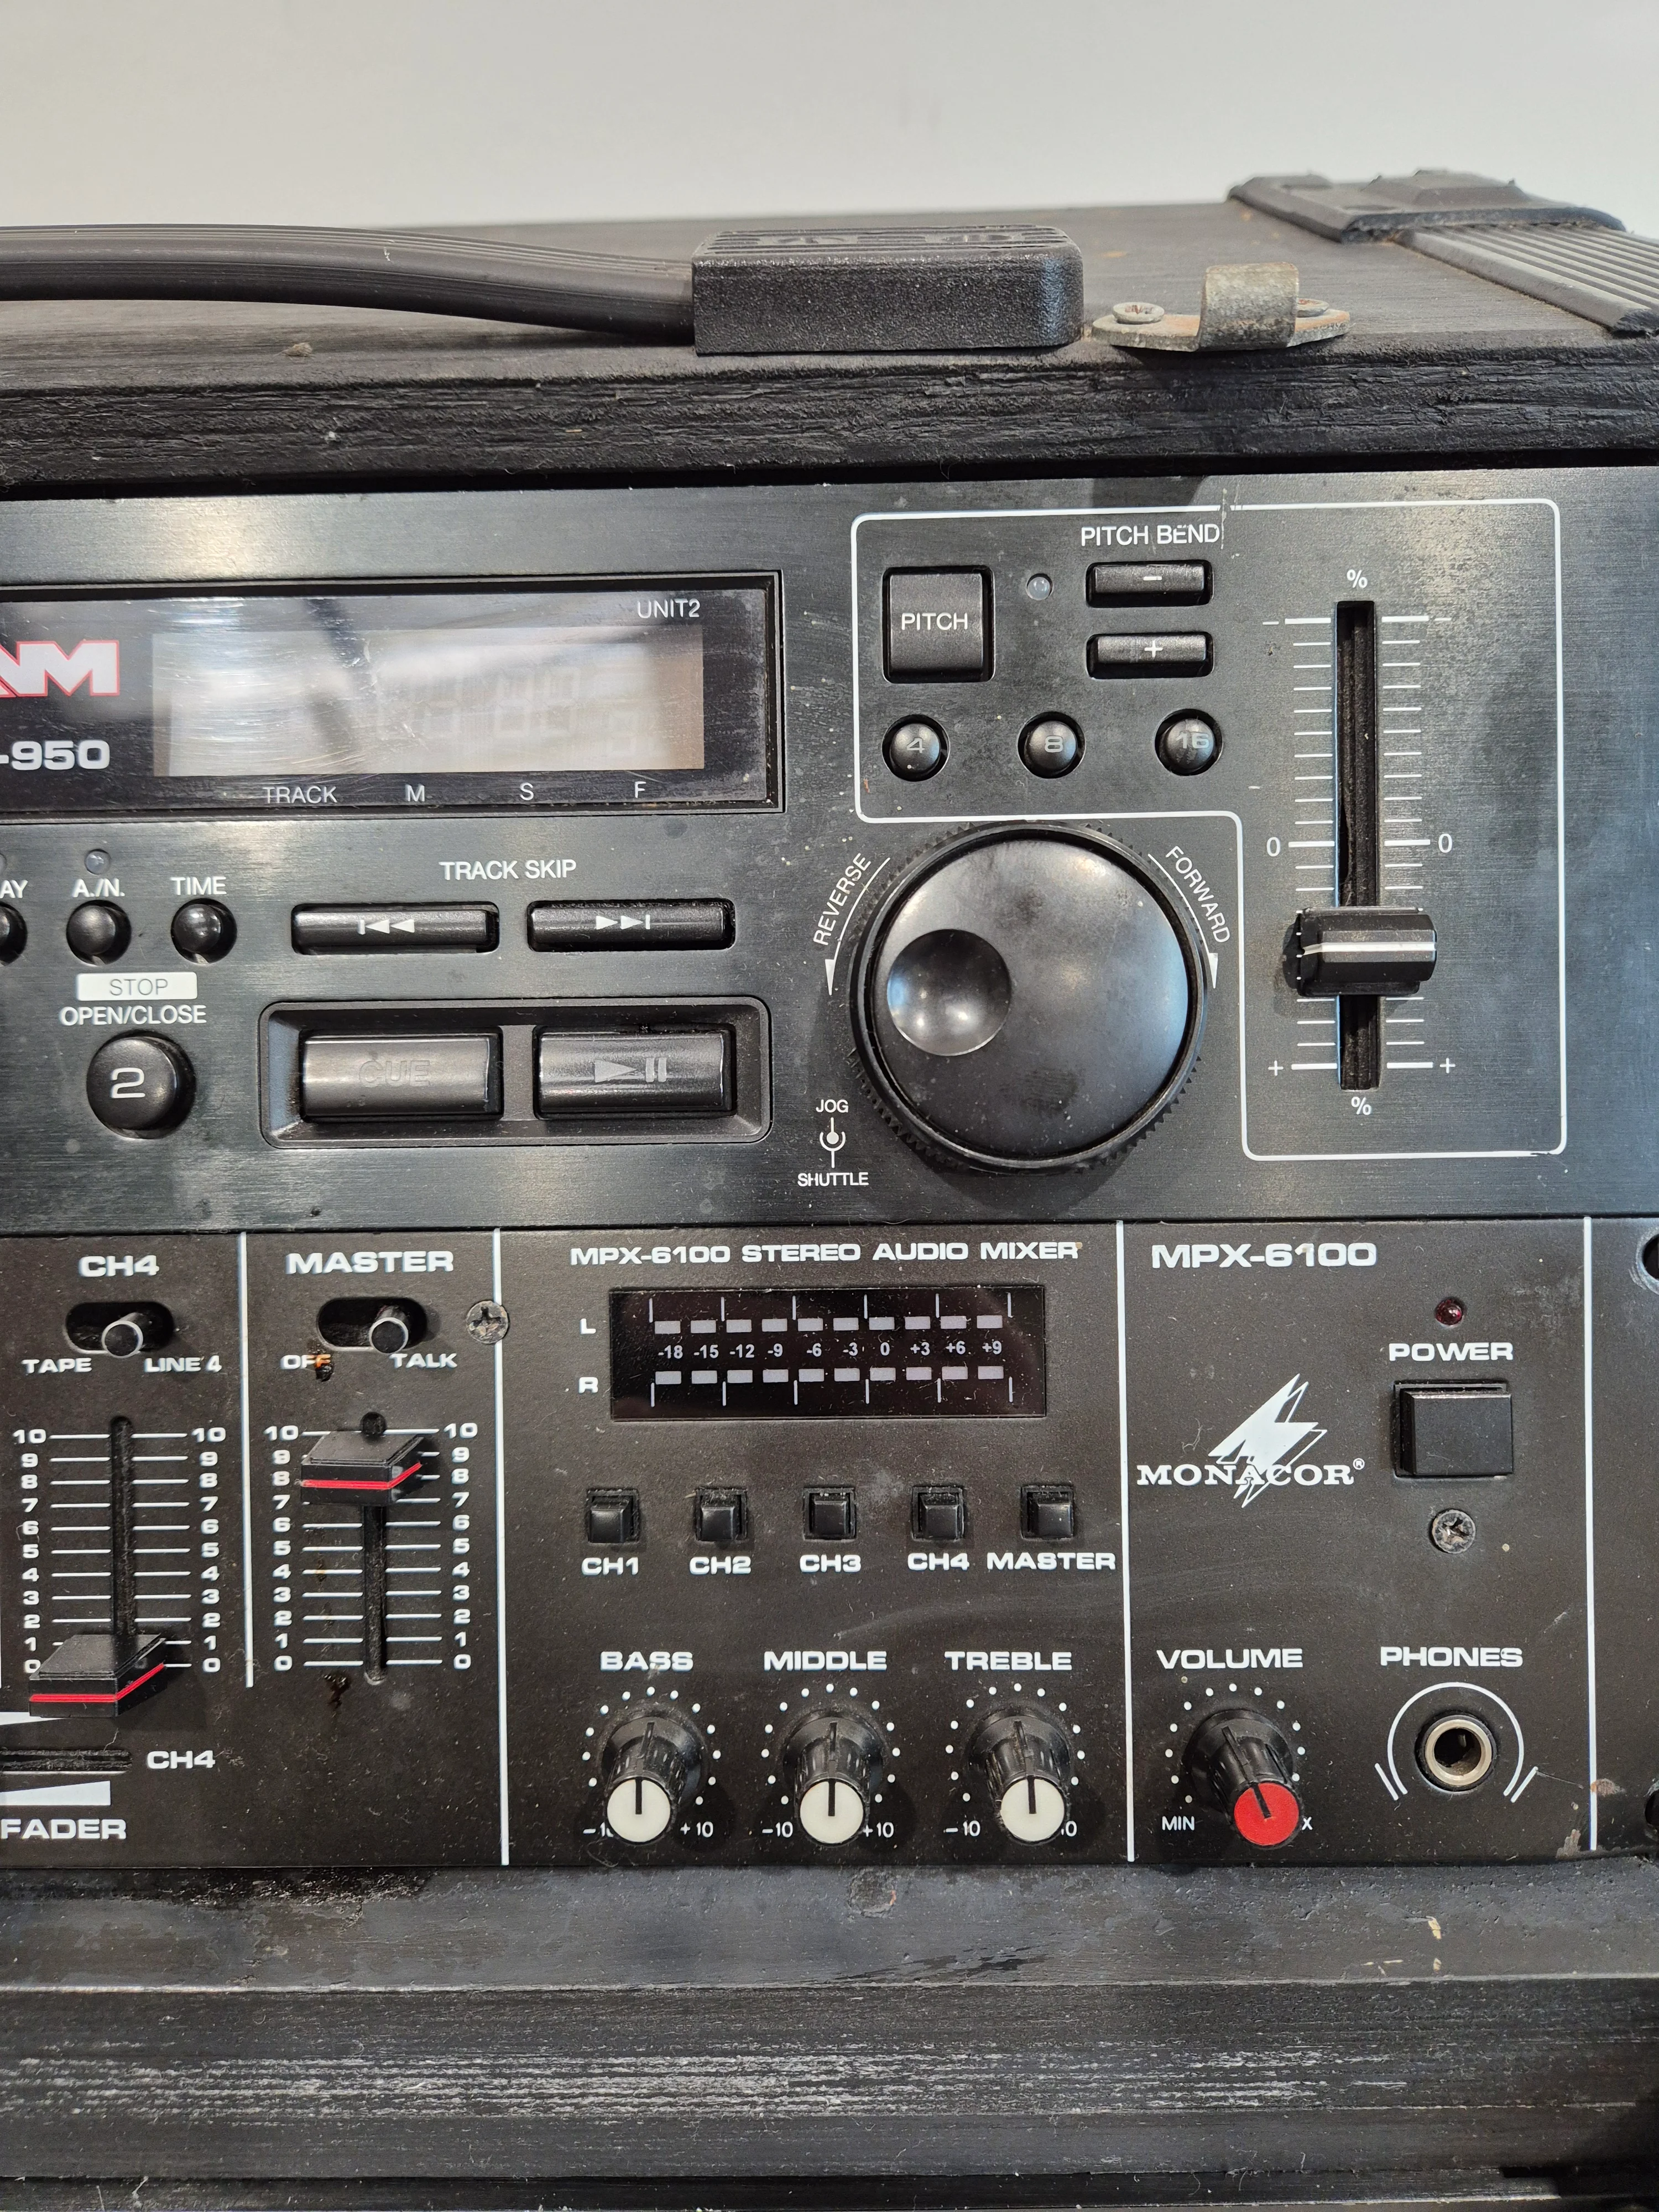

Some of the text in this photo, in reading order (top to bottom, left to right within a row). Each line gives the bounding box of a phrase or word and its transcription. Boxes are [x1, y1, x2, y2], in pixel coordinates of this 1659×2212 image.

[1081, 523, 1220, 546] PITCH BEND
[1346, 569, 1368, 588] %
[637, 598, 701, 618] UNIT2
[901, 612, 968, 631] PITCH
[905, 737, 926, 754] 4
[1044, 734, 1065, 753] 8
[1173, 731, 1211, 750] 16
[0, 739, 110, 771] -950
[261, 785, 337, 804] TRACK
[405, 784, 425, 802] M
[519, 782, 534, 801] S
[634, 781, 647, 799] F
[1266, 837, 1281, 857] 0
[1438, 833, 1453, 853] 0
[439, 859, 577, 880] TRACK SKIP
[72, 878, 125, 898] A./N.
[170, 875, 227, 895] TIME
[812, 853, 873, 947] REVERSE
[1165, 845, 1231, 945] FORWARD
[108, 978, 169, 996] STOP
[60, 1004, 207, 1026] OPEN/CLOSE
[110, 1066, 146, 1099] 2
[359, 1061, 430, 1088] CUE
[815, 1099, 849, 1113] JOG
[1351, 1096, 1372, 1115] %
[797, 1172, 869, 1187] SHUTTLE
[287, 1250, 454, 1274] MASTER
[570, 1241, 1079, 1266] MPX-6100 STEREO AUDIO MIXER
[1151, 1242, 1377, 1269] MPX-6100
[79, 1255, 160, 1277] CH4
[580, 1318, 596, 1334] L
[658, 1340, 1002, 1359] -18 -15 -12 -9 -6 -3 0 +3 +6 +9
[1389, 1342, 1514, 1361] POWER
[22, 1357, 92, 1374] TAPE
[143, 1355, 222, 1374] LINE 4
[280, 1352, 331, 1371] OFF
[389, 1353, 458, 1368] TALK
[578, 1376, 598, 1394] R
[13, 1428, 46, 1444] 10
[191, 1427, 226, 1442] 10
[264, 1425, 299, 1441] 10
[444, 1422, 478, 1438] 10
[21, 1453, 38, 1468] 9
[200, 1451, 218, 1467] 9
[452, 1447, 469, 1463] 9
[21, 1474, 38, 1489] 8
[200, 1473, 218, 1488] 8
[272, 1470, 290, 1486] 8
[451, 1468, 469, 1484] 8
[21, 1498, 38, 1512] 7
[200, 1496, 218, 1511] 7
[273, 1494, 290, 1510] 7
[452, 1491, 469, 1507] 7
[22, 1520, 39, 1535] 6
[201, 1519, 219, 1534] 6
[273, 1517, 291, 1532] 6
[452, 1514, 470, 1531] 6
[23, 1543, 39, 1559] 5
[201, 1542, 220, 1558] 5
[273, 1540, 291, 1556] 5
[453, 1537, 470, 1553] 5
[452, 1562, 470, 1577] 4
[581, 1557, 639, 1575] CH1
[689, 1556, 752, 1575] CH2
[799, 1554, 862, 1572] CH3
[907, 1552, 970, 1571] CH4
[987, 1552, 1116, 1570] MASTER
[22, 1567, 39, 1582] 4
[201, 1566, 220, 1581] 4
[273, 1563, 291, 1579] 4
[23, 1590, 39, 1605] 3
[202, 1589, 220, 1604] 3
[273, 1587, 291, 1603] 3
[452, 1585, 470, 1600] 3
[23, 1614, 40, 1629] 2
[202, 1612, 221, 1627] 2
[274, 1610, 292, 1626] 2
[453, 1609, 471, 1624] 2
[24, 1637, 36, 1651] 1
[204, 1635, 216, 1650] 1
[275, 1633, 288, 1648] 1
[455, 1631, 466, 1647] 1
[202, 1657, 221, 1673] 0
[274, 1655, 293, 1671] 0
[453, 1653, 471, 1670] 0
[601, 1651, 693, 1671] BASS
[764, 1651, 888, 1671] MIDDLE
[944, 1651, 1072, 1671] TREBLE
[1156, 1648, 1303, 1670] VOLUME
[1380, 1646, 1523, 1667] PHONES
[24, 1658, 41, 1674] 0
[146, 1750, 216, 1770] CH4
[1, 1818, 127, 1840] FADER
[583, 1822, 614, 1837] -1
[680, 1821, 714, 1838] +10
[761, 1820, 794, 1839] -10
[862, 1822, 894, 1838] +10
[945, 1819, 981, 1837] -10
[1162, 1815, 1195, 1831] MIN
